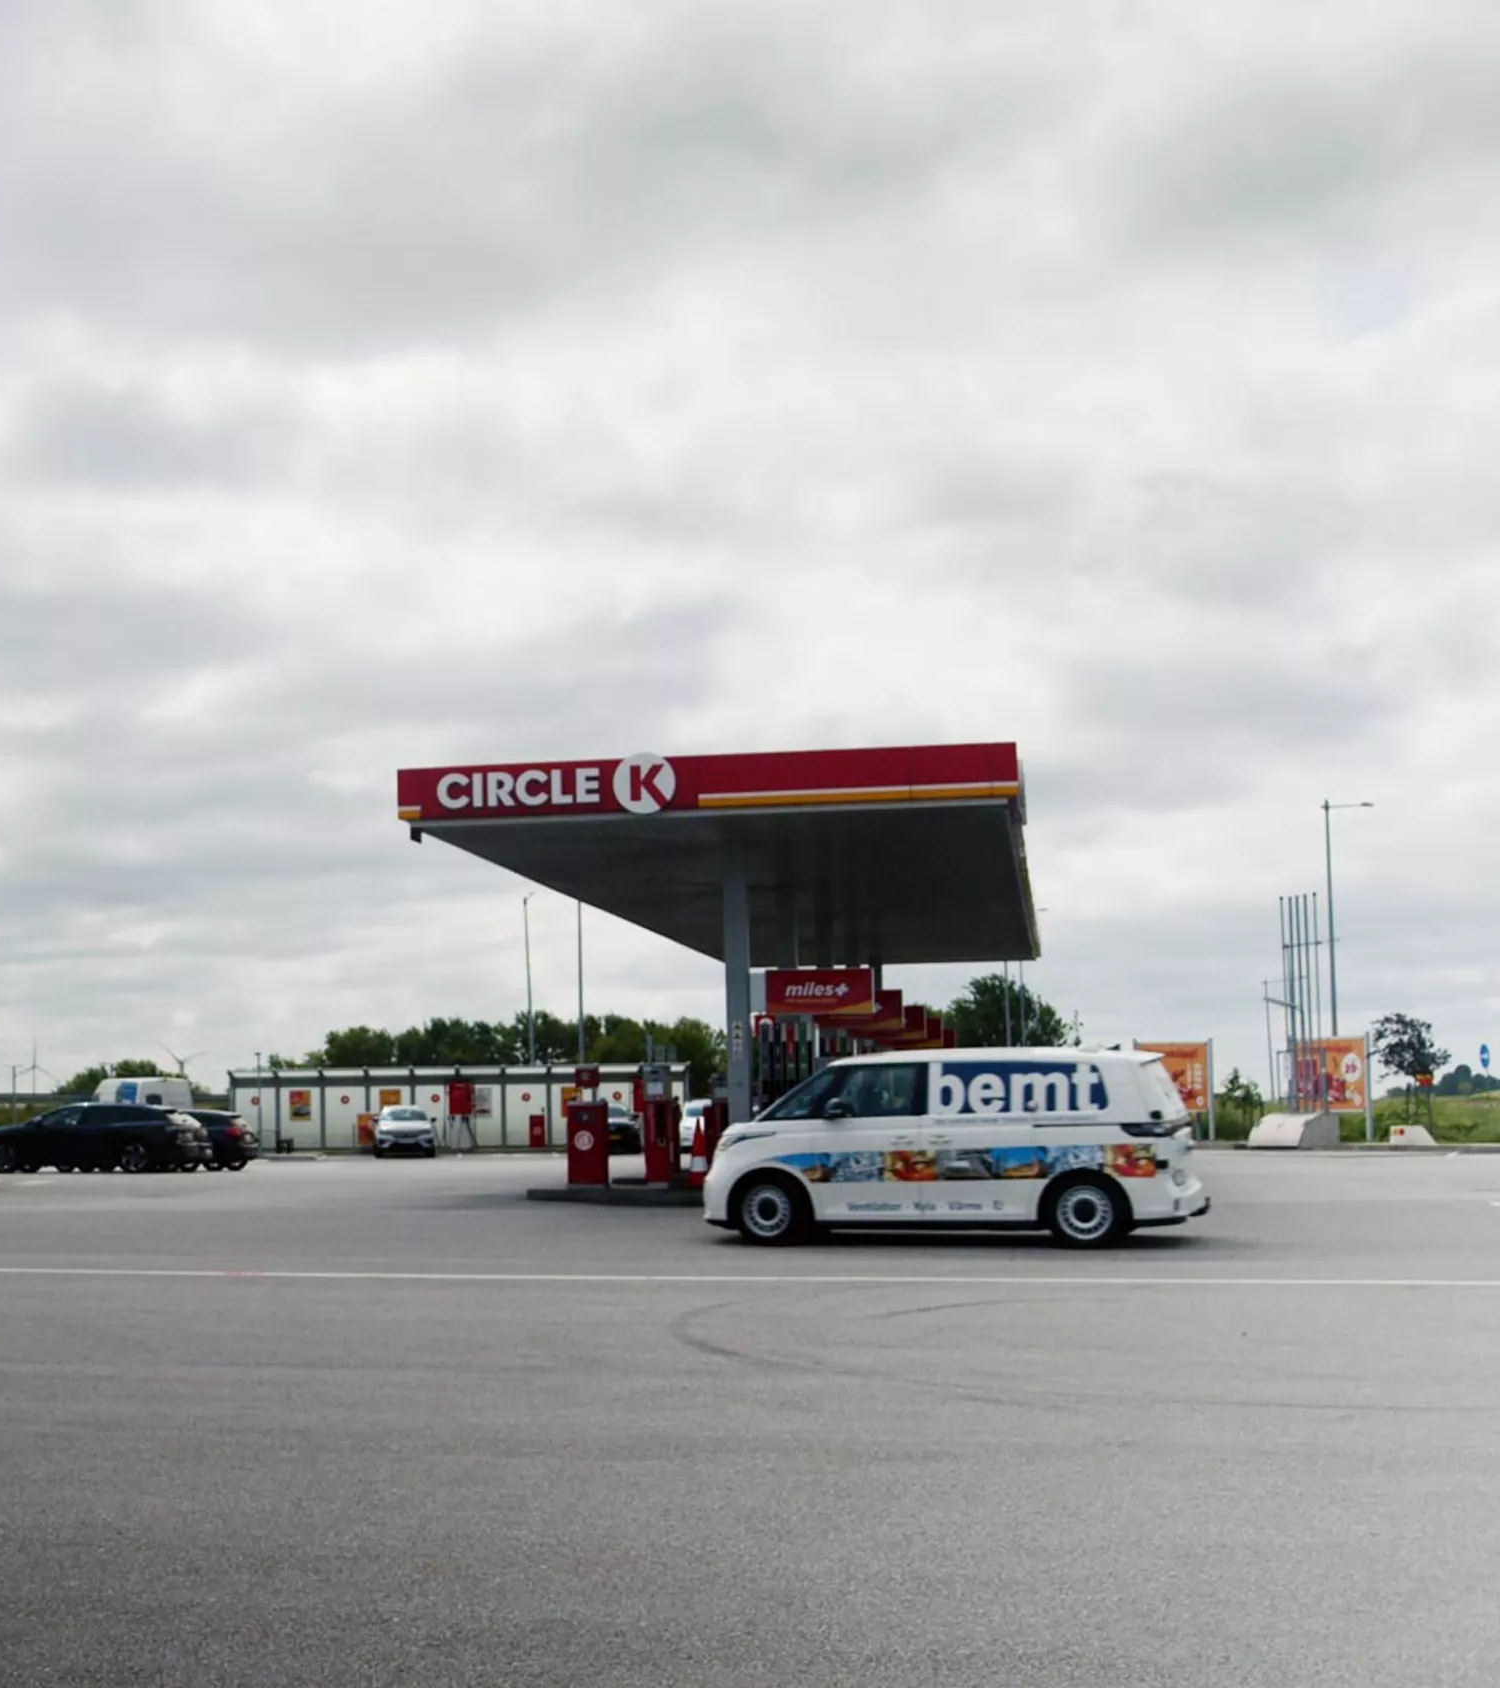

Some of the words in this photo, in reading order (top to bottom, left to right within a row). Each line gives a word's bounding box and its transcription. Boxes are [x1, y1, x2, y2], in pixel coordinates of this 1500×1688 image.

[436, 768, 600, 809] CIRCLE
[622, 758, 674, 811] K
[928, 1062, 1102, 1114] bemt
